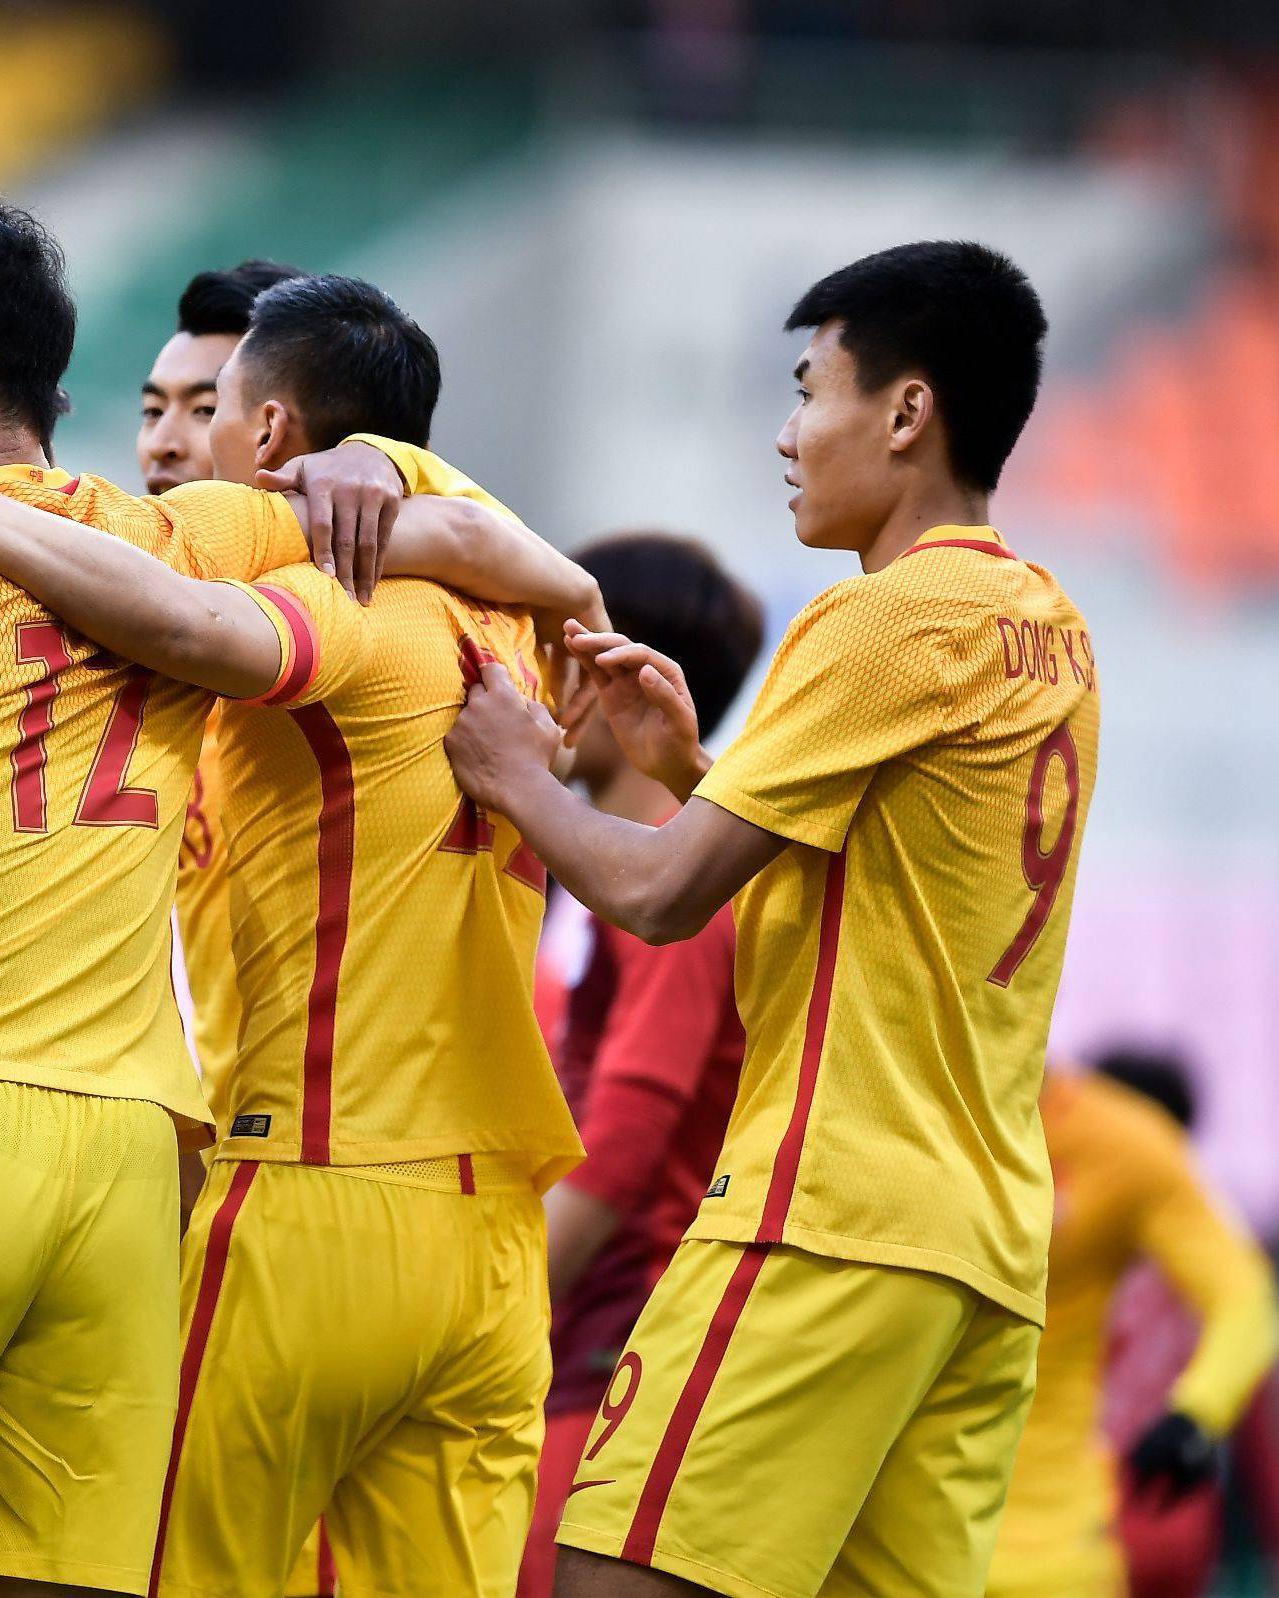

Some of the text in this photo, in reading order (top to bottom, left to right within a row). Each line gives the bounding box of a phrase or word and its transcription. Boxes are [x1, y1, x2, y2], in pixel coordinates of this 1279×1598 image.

[11, 620, 159, 833] 12
[997, 617, 1058, 686] DONG
[986, 721, 1080, 989] 9
[585, 1351, 642, 1461] 9
